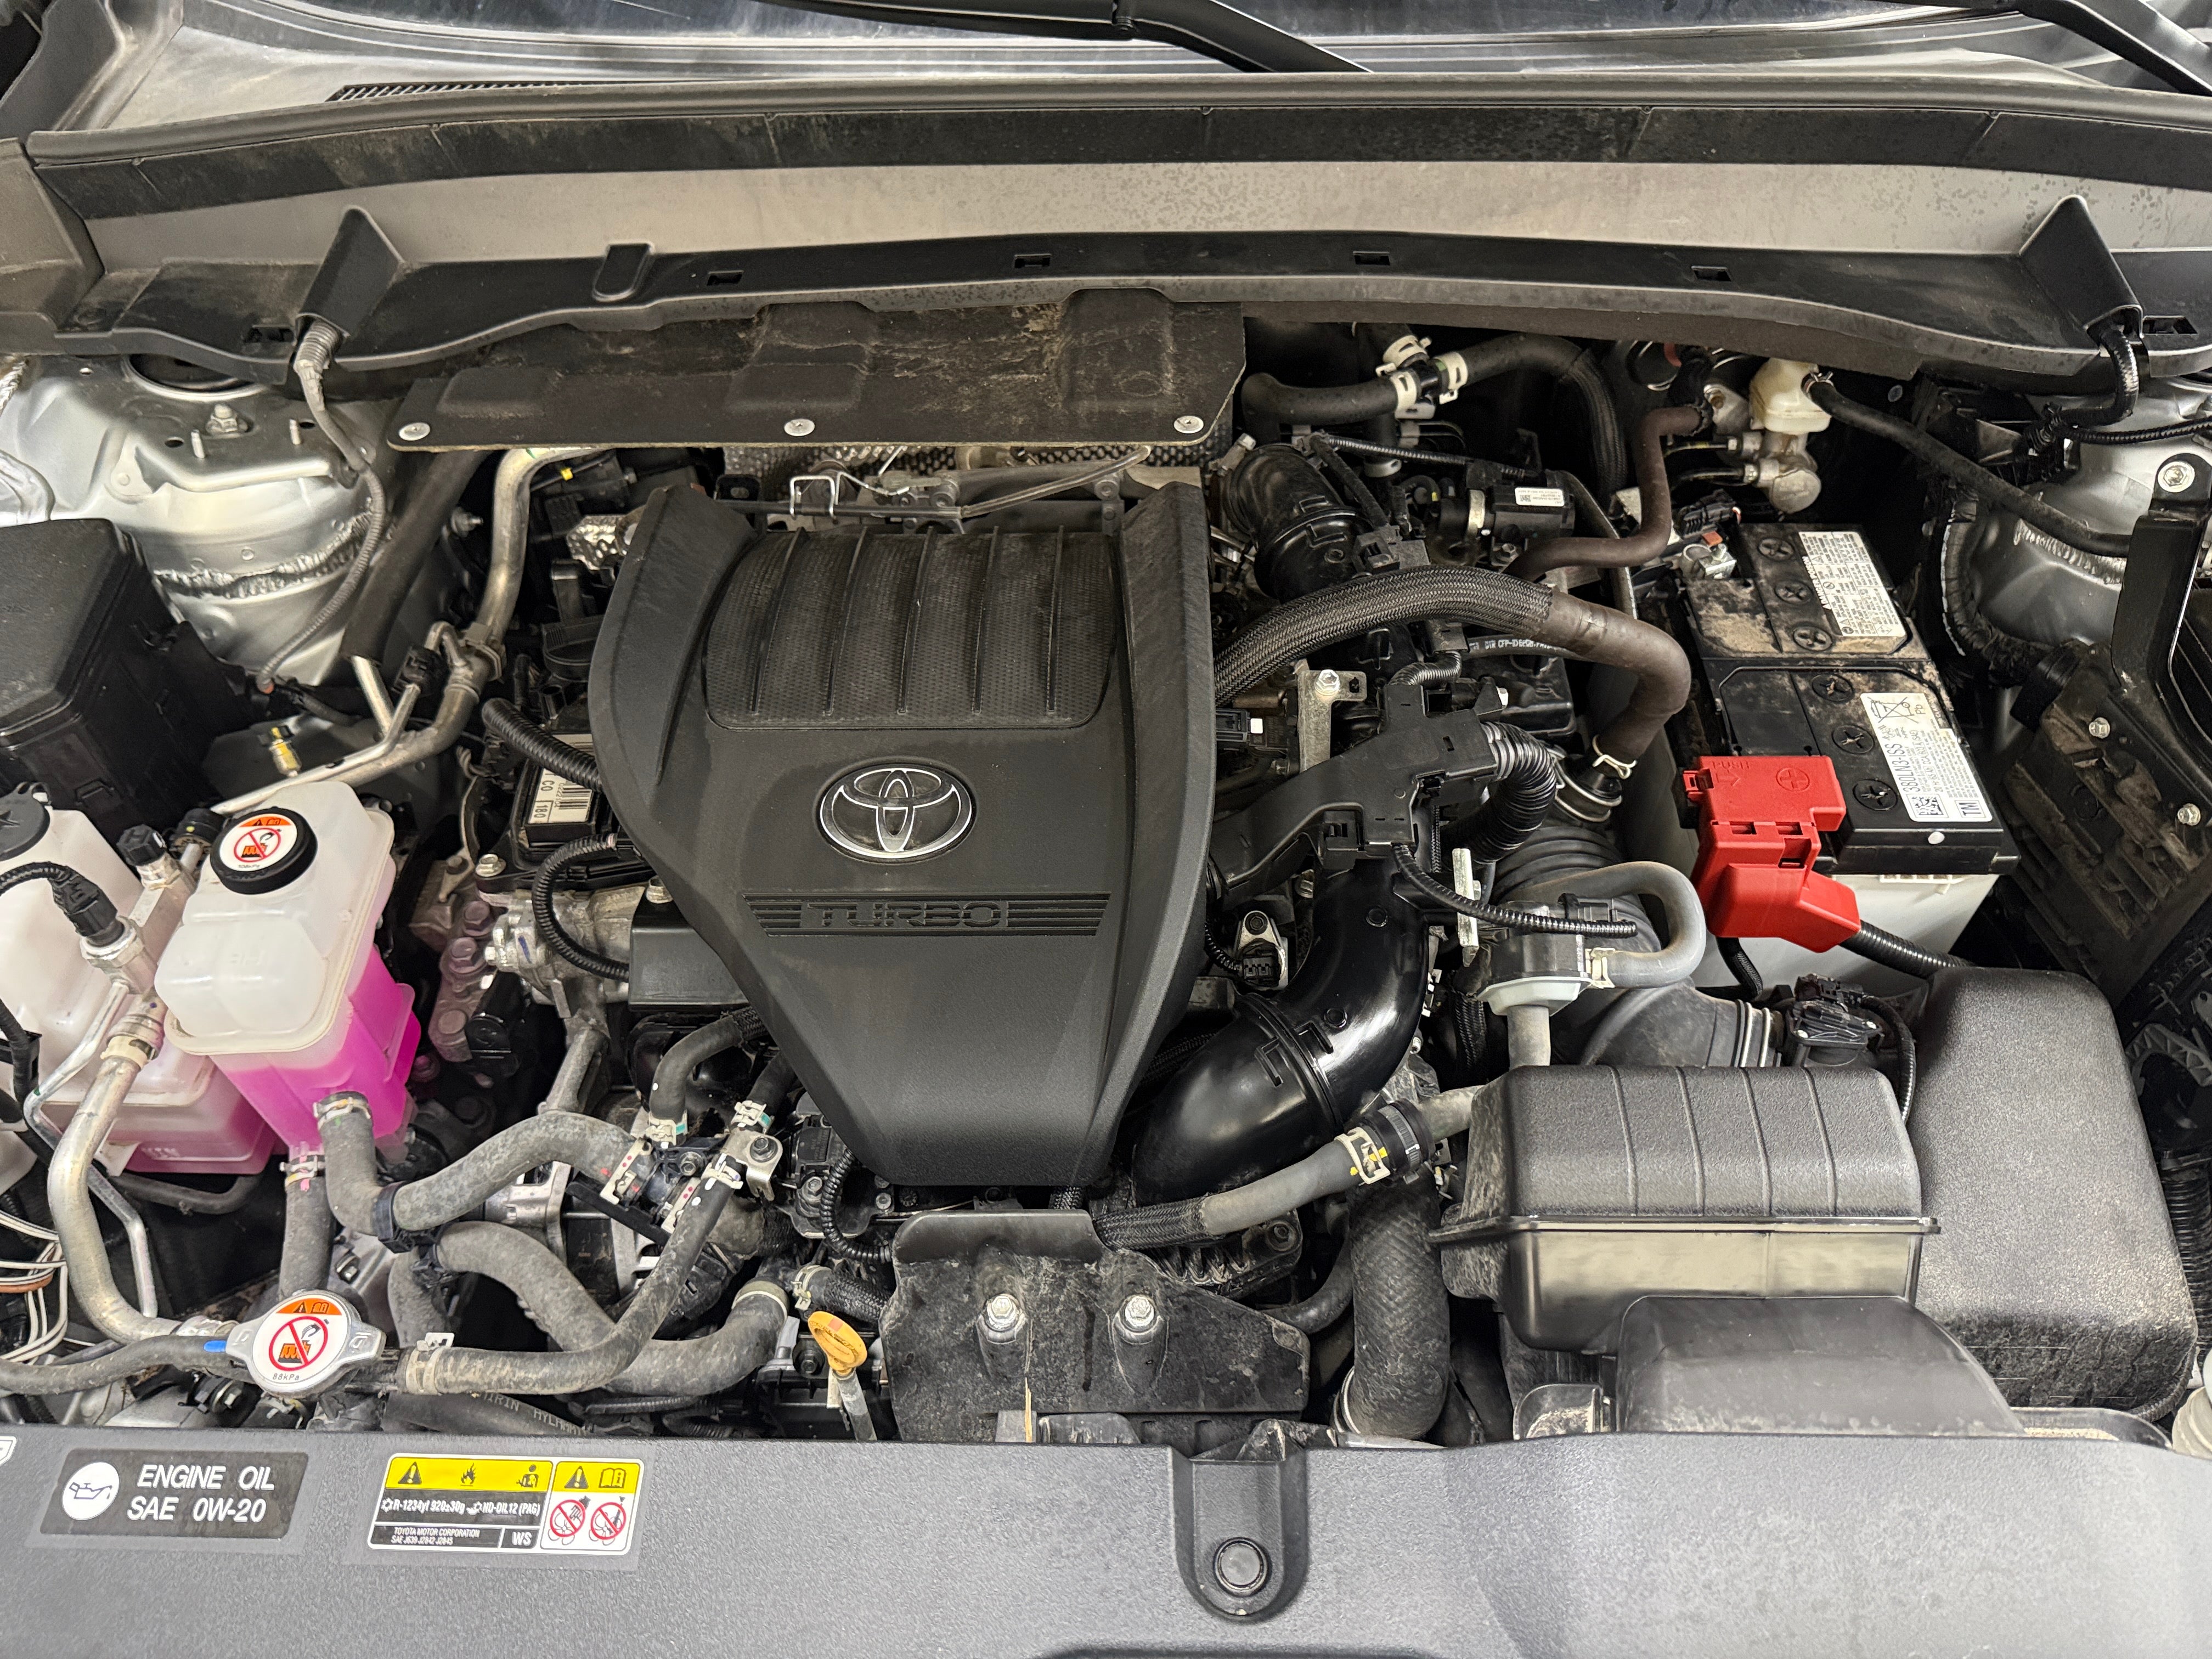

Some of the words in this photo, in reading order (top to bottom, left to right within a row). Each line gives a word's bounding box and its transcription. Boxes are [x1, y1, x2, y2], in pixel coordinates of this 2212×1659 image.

[1802, 556, 1817, 579] POISON
[1812, 579, 1829, 604] DANGER
[1915, 704, 1926, 714] Pb
[1712, 760, 1750, 769] PUSH
[1883, 743, 1921, 792] 380LN3-ISS
[534, 805, 549, 818] 180
[1958, 802, 1982, 816] TM
[806, 901, 1003, 927] TURBO
[137, 1464, 226, 1489] ENGINE
[238, 1465, 275, 1491] OIL
[127, 1495, 179, 1521] SAE
[193, 1497, 267, 1523] 0W-20
[518, 1503, 541, 1517] (PAG)
[391, 1534, 404, 1544] SAE
[394, 1527, 416, 1536] TOYOTA
[416, 1527, 439, 1537] MOTOR
[438, 1528, 481, 1538] CORPORATION
[511, 1532, 533, 1546] WS
